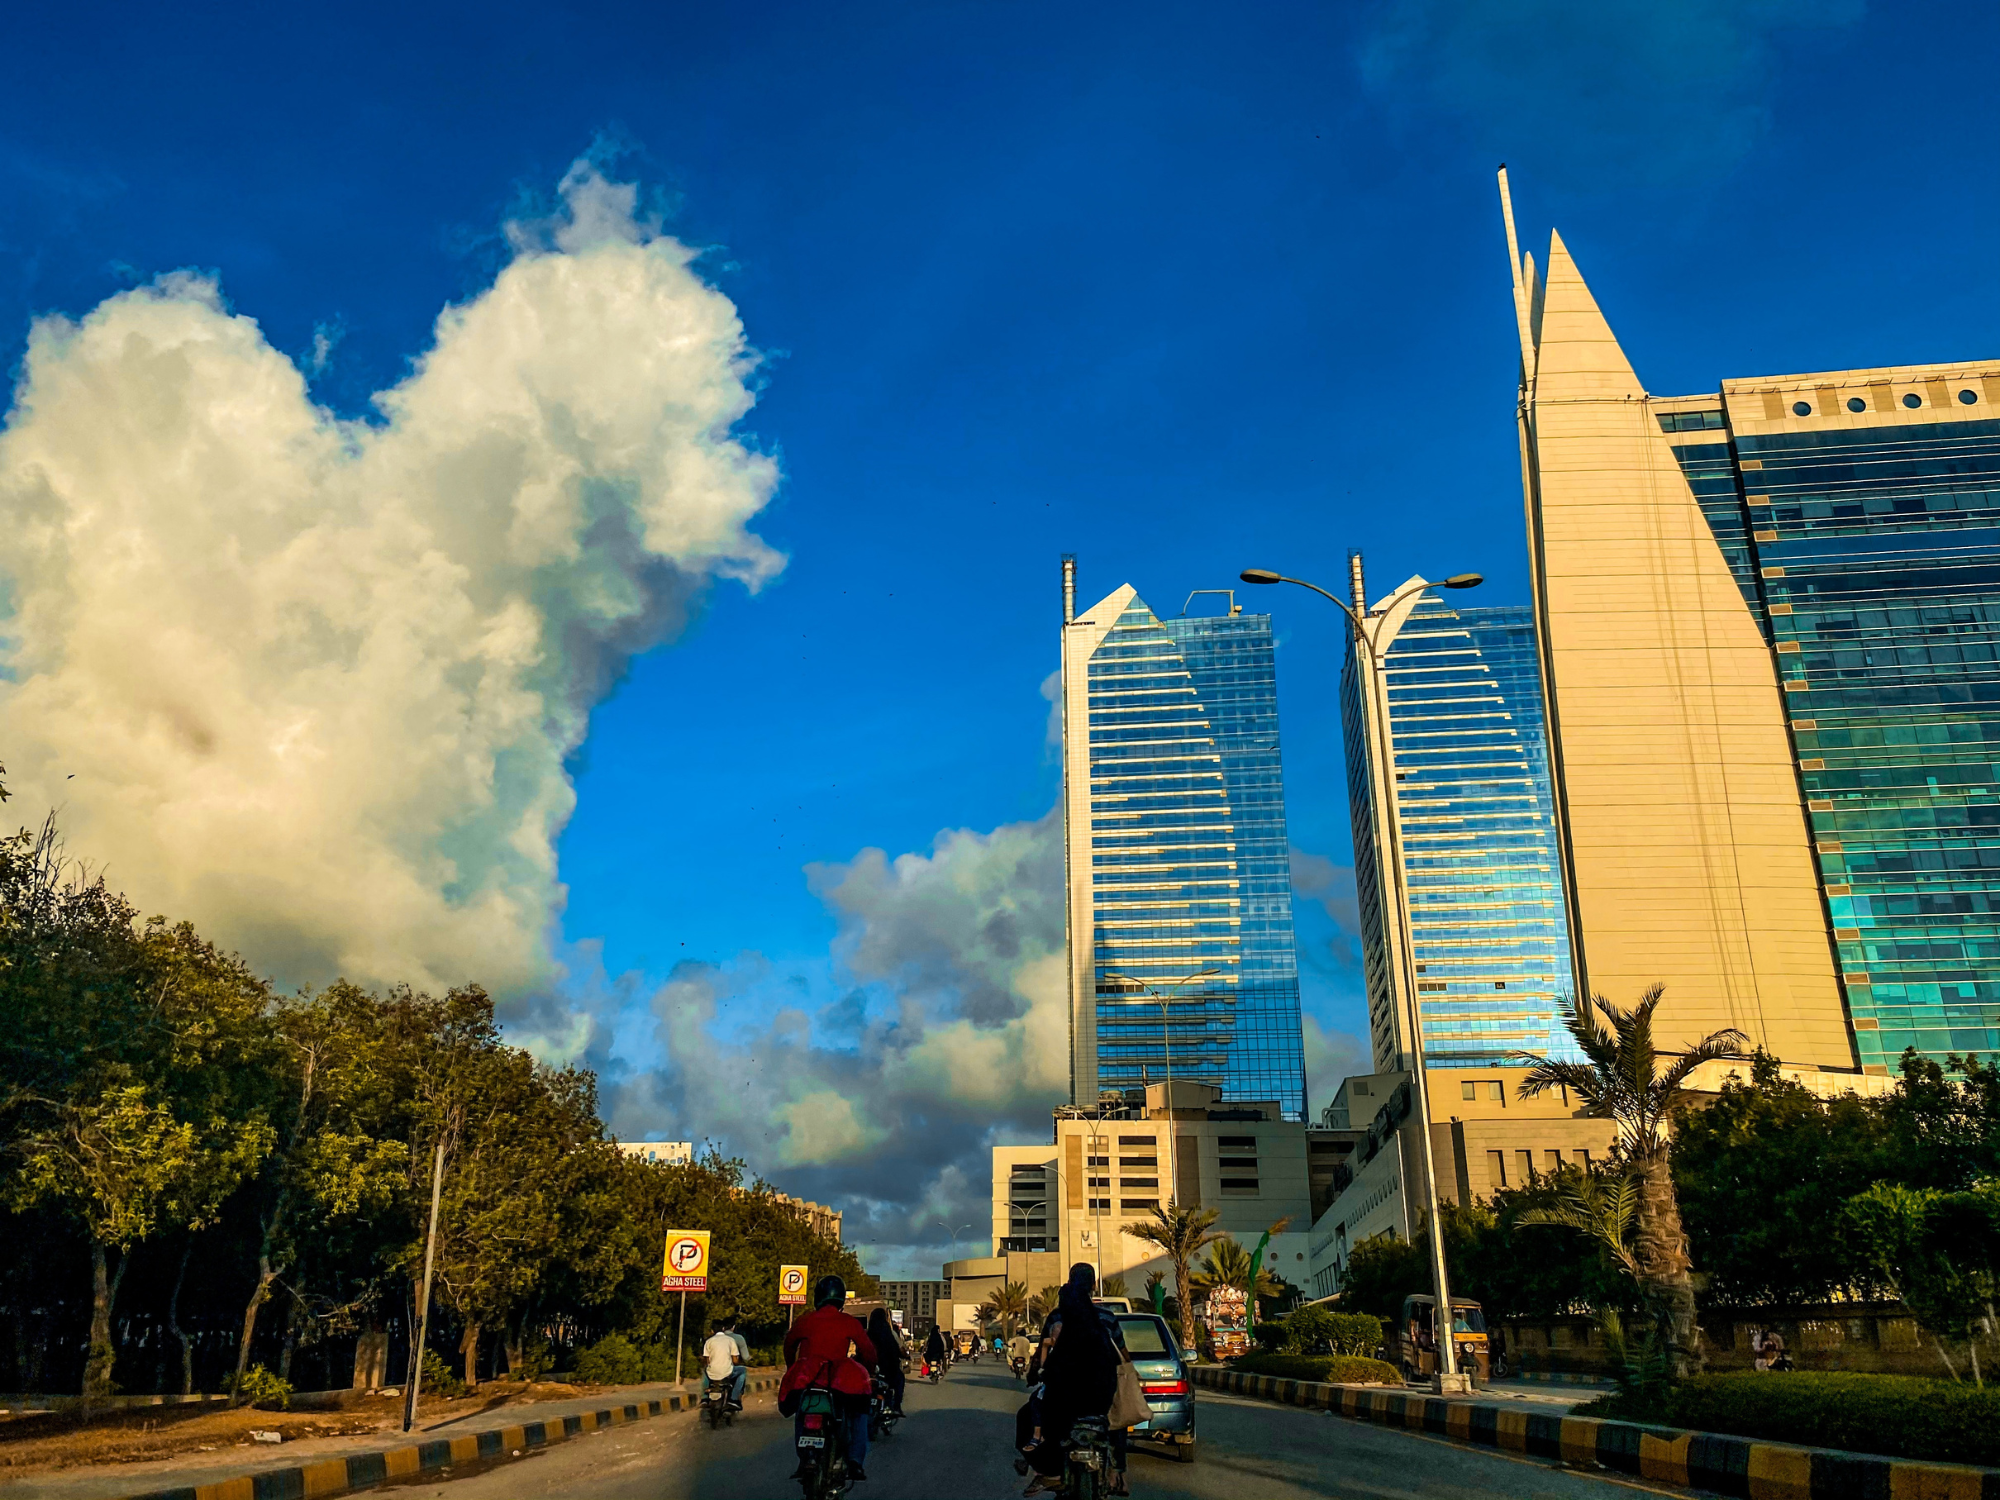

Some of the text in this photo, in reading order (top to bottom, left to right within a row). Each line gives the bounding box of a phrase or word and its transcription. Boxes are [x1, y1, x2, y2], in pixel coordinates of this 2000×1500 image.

[680, 1244, 698, 1268] P
[663, 1277, 705, 1287] AGHA STEEL
[789, 1274, 800, 1289] P
